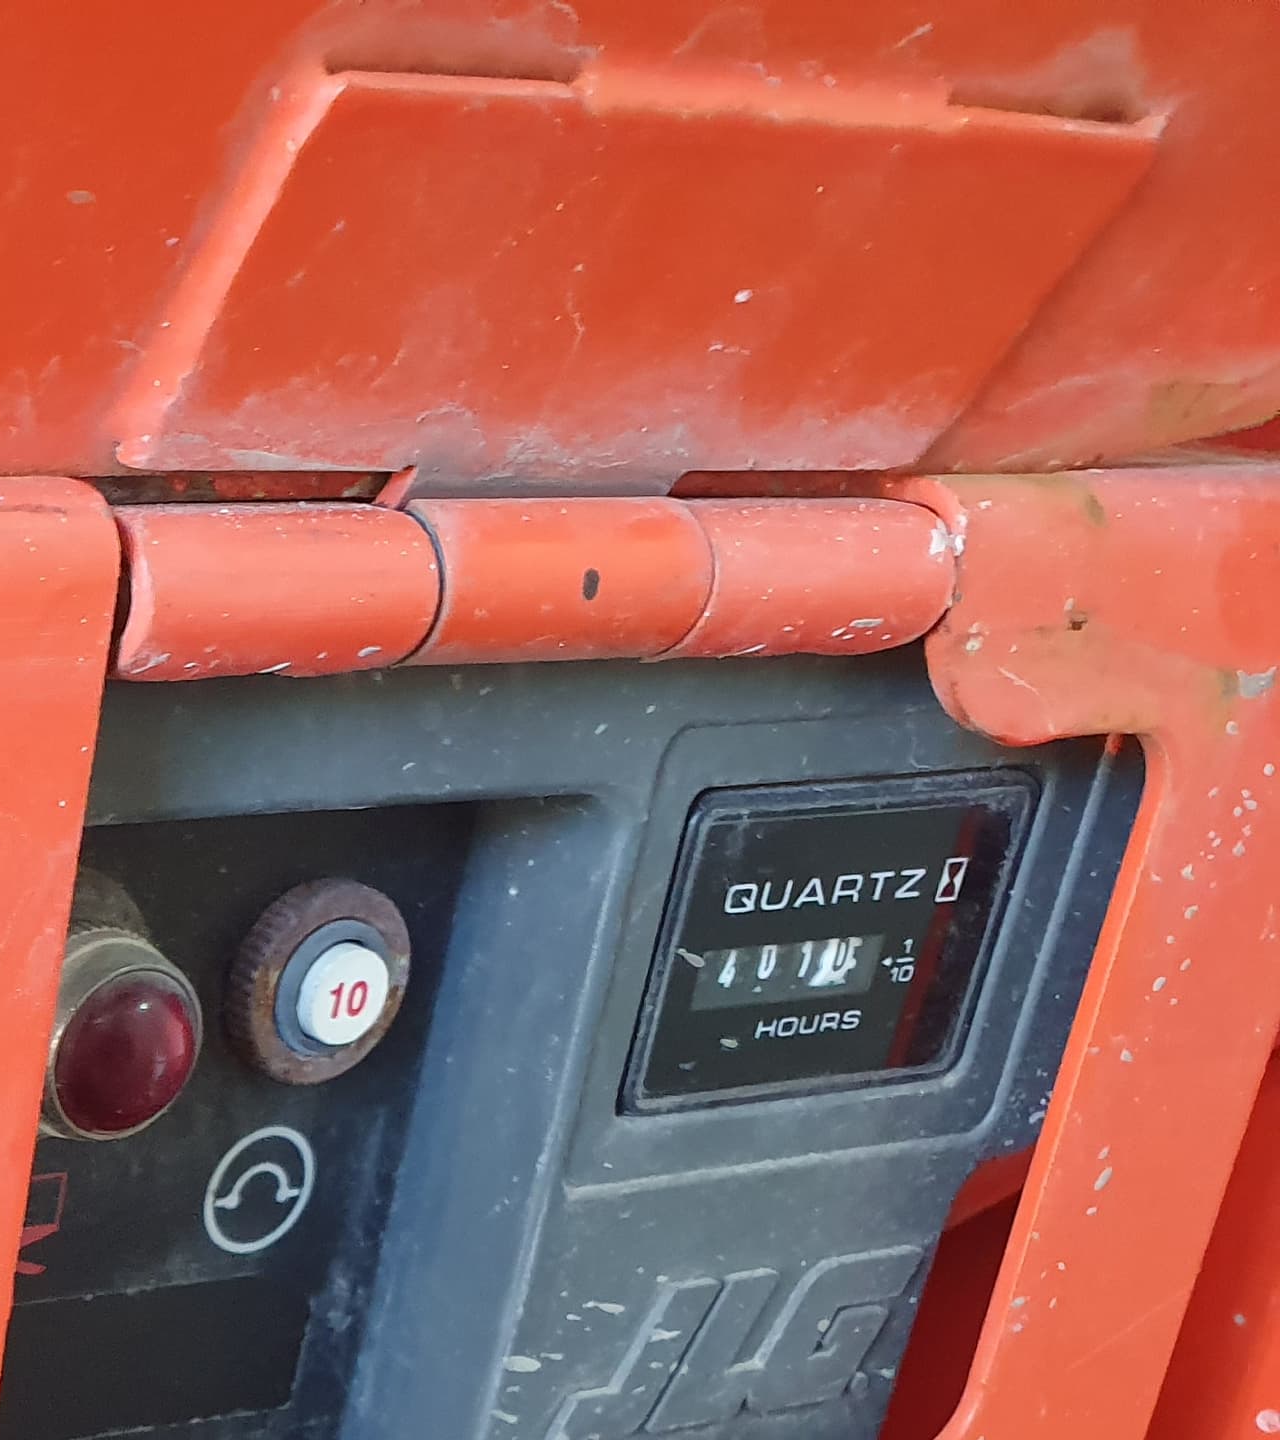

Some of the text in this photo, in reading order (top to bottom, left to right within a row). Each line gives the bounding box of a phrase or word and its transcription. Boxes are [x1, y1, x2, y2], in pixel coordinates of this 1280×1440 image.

[724, 869, 926, 914] QUARTZ
[329, 980, 369, 1019] 10
[754, 1009, 863, 1040] HOURS
